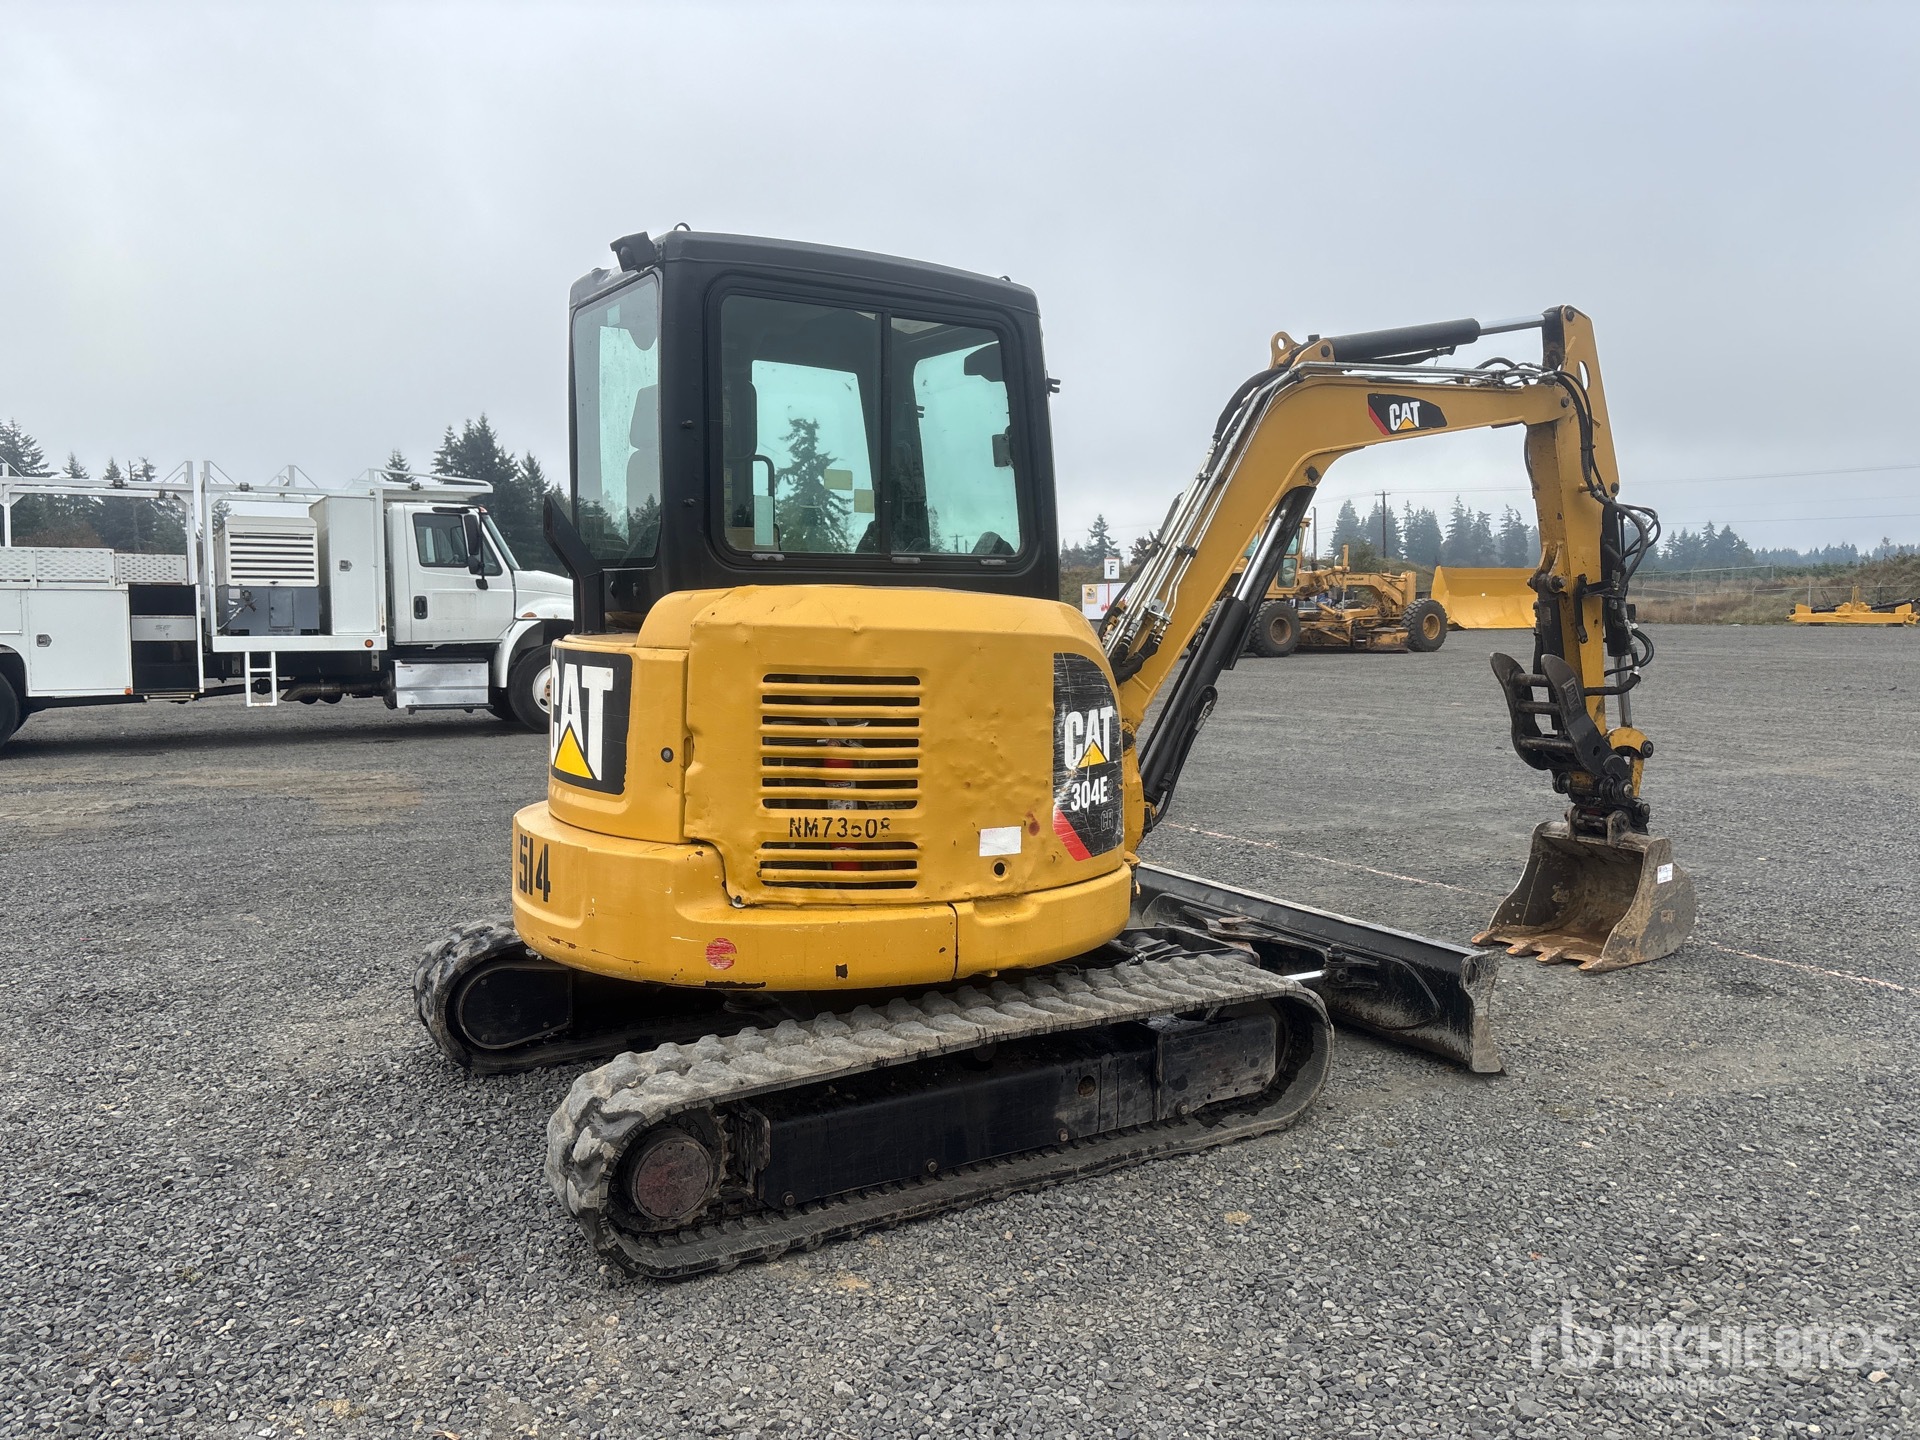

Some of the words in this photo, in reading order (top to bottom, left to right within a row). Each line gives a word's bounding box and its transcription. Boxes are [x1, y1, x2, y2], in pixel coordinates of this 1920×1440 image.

[1389, 401, 1420, 431] CAT
[1110, 565, 1115, 575] F
[551, 658, 614, 781] CAT
[1064, 705, 1114, 770] CAT
[519, 833, 551, 903] 514
